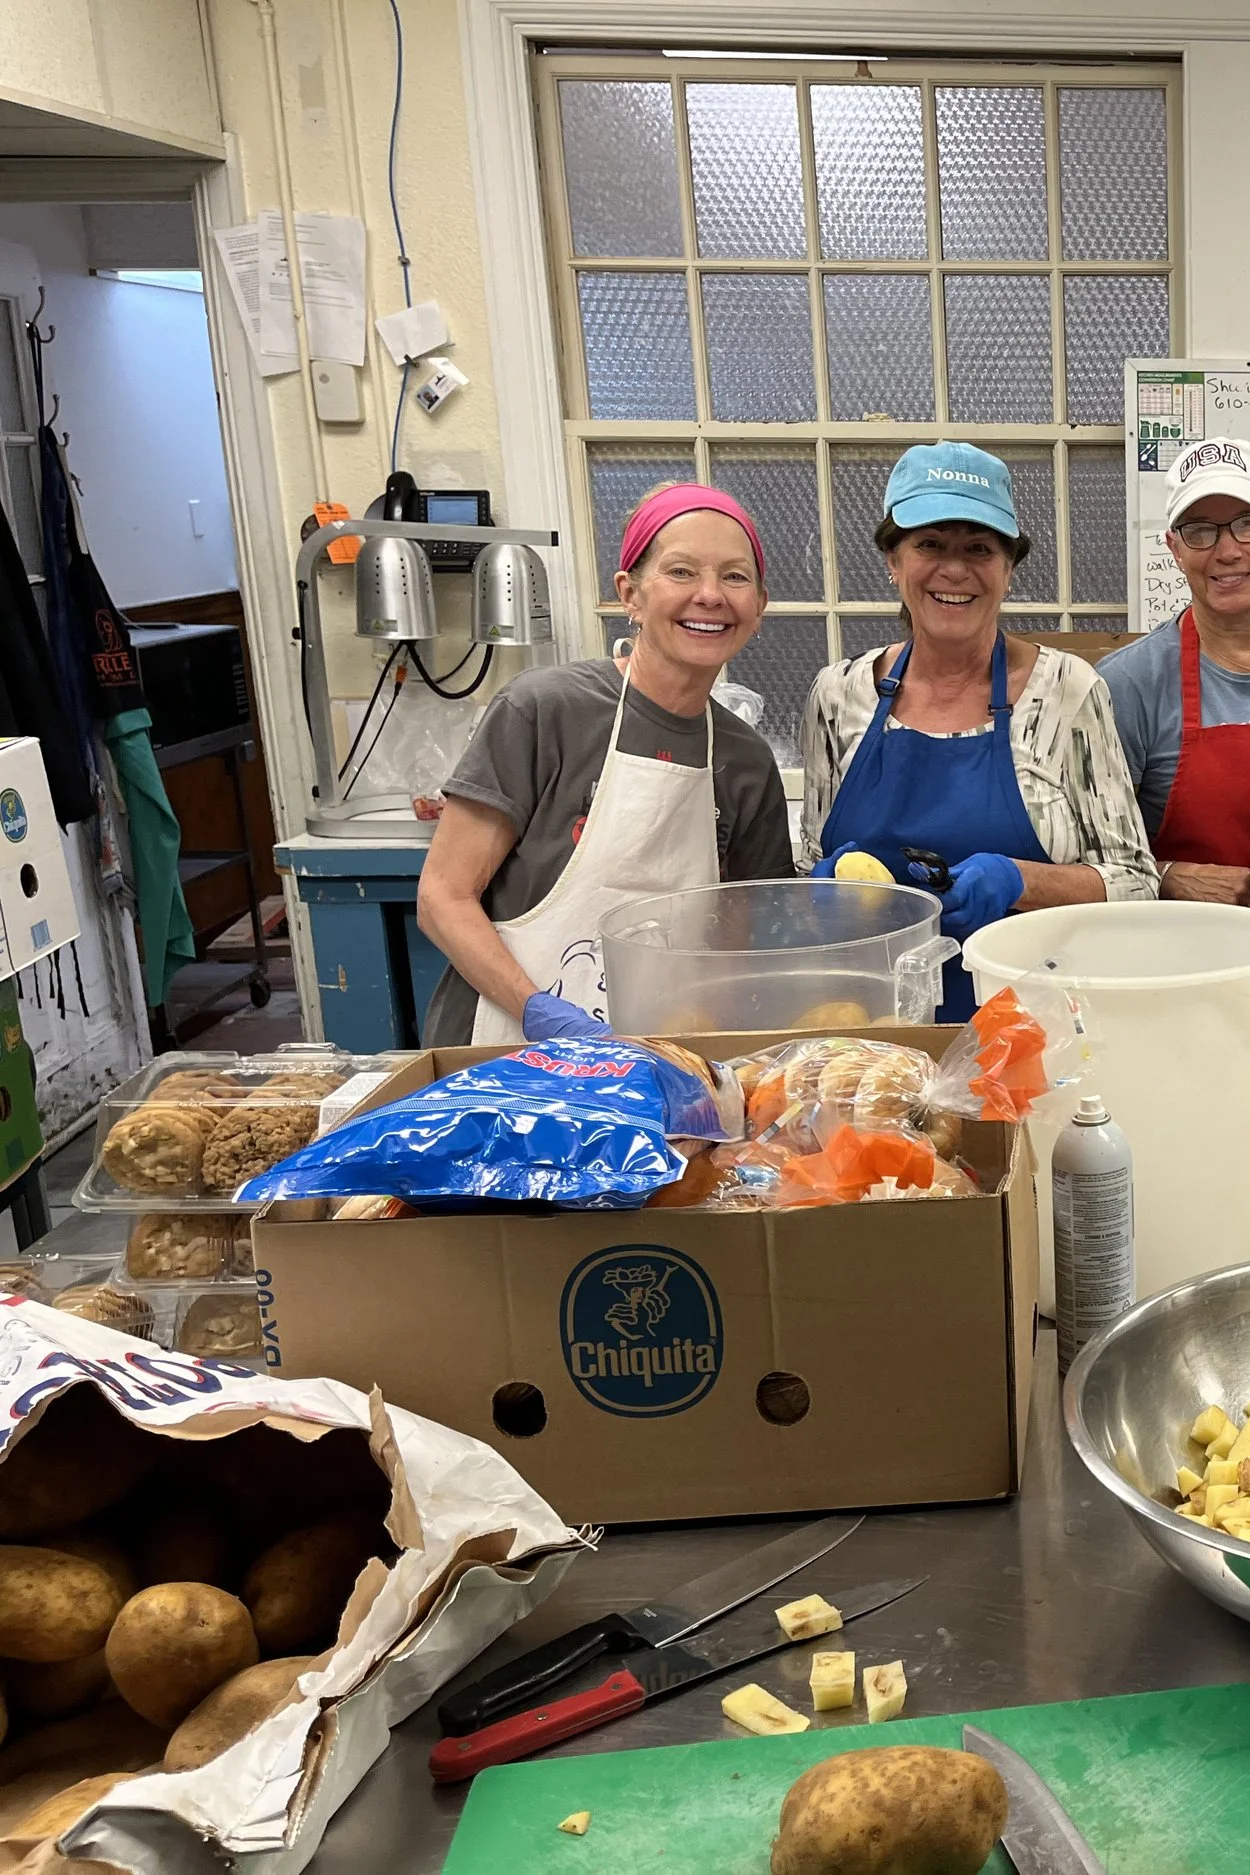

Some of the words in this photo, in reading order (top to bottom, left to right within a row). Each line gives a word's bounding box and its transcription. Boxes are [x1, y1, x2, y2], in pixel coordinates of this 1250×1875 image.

[1180, 443, 1247, 482] USA
[925, 467, 990, 489] Nonna
[553, 1050, 596, 1063] LIGHT
[571, 1337, 715, 1387] Chiquita
